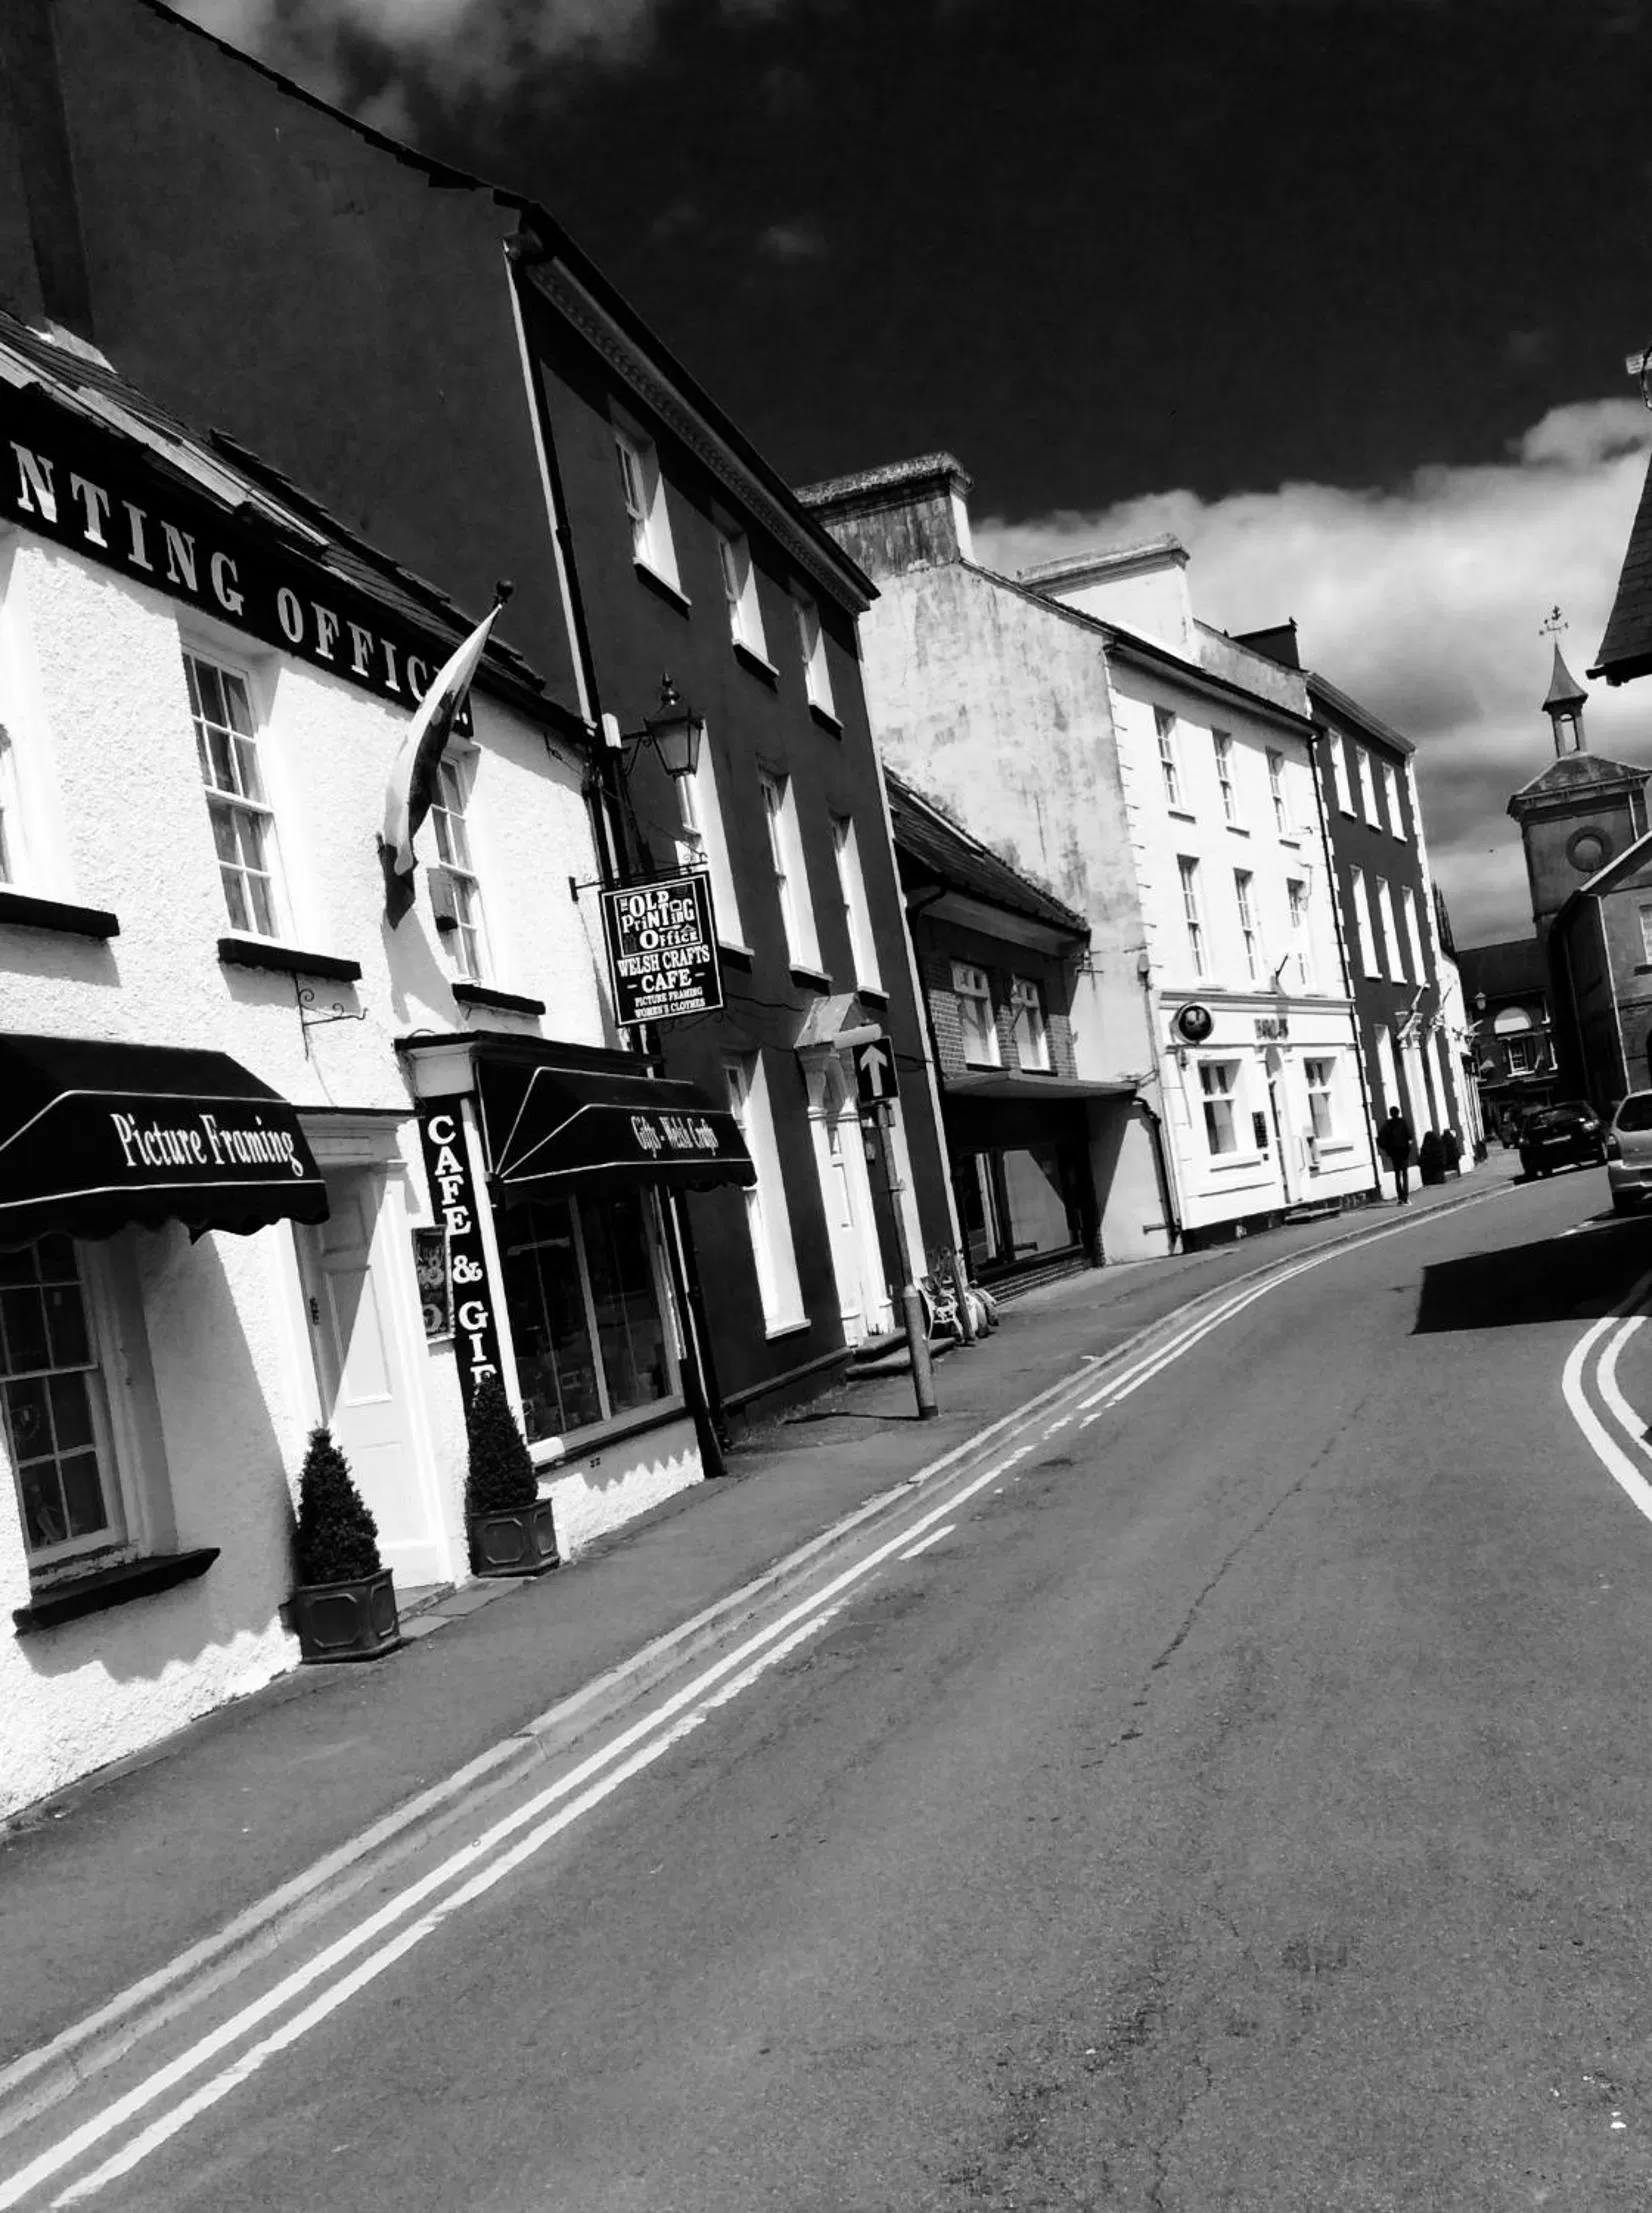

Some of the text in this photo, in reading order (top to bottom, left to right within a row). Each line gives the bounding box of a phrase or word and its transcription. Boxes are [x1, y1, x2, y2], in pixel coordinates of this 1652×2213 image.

[10, 440, 244, 616] NTING
[629, 890, 670, 918] OLD
[617, 944, 711, 977] WELSH CRAFTS
[634, 986, 703, 1008] PICTURE FRAMING
[641, 968, 692, 993] CAFE
[670, 997, 706, 1013] CLOTHES
[110, 1113, 304, 1177] Picture Framing
[631, 1116, 719, 1158] Gifts Welsh Crafts
[428, 1115, 472, 1236] CAFE
[452, 1255, 483, 1284] &
